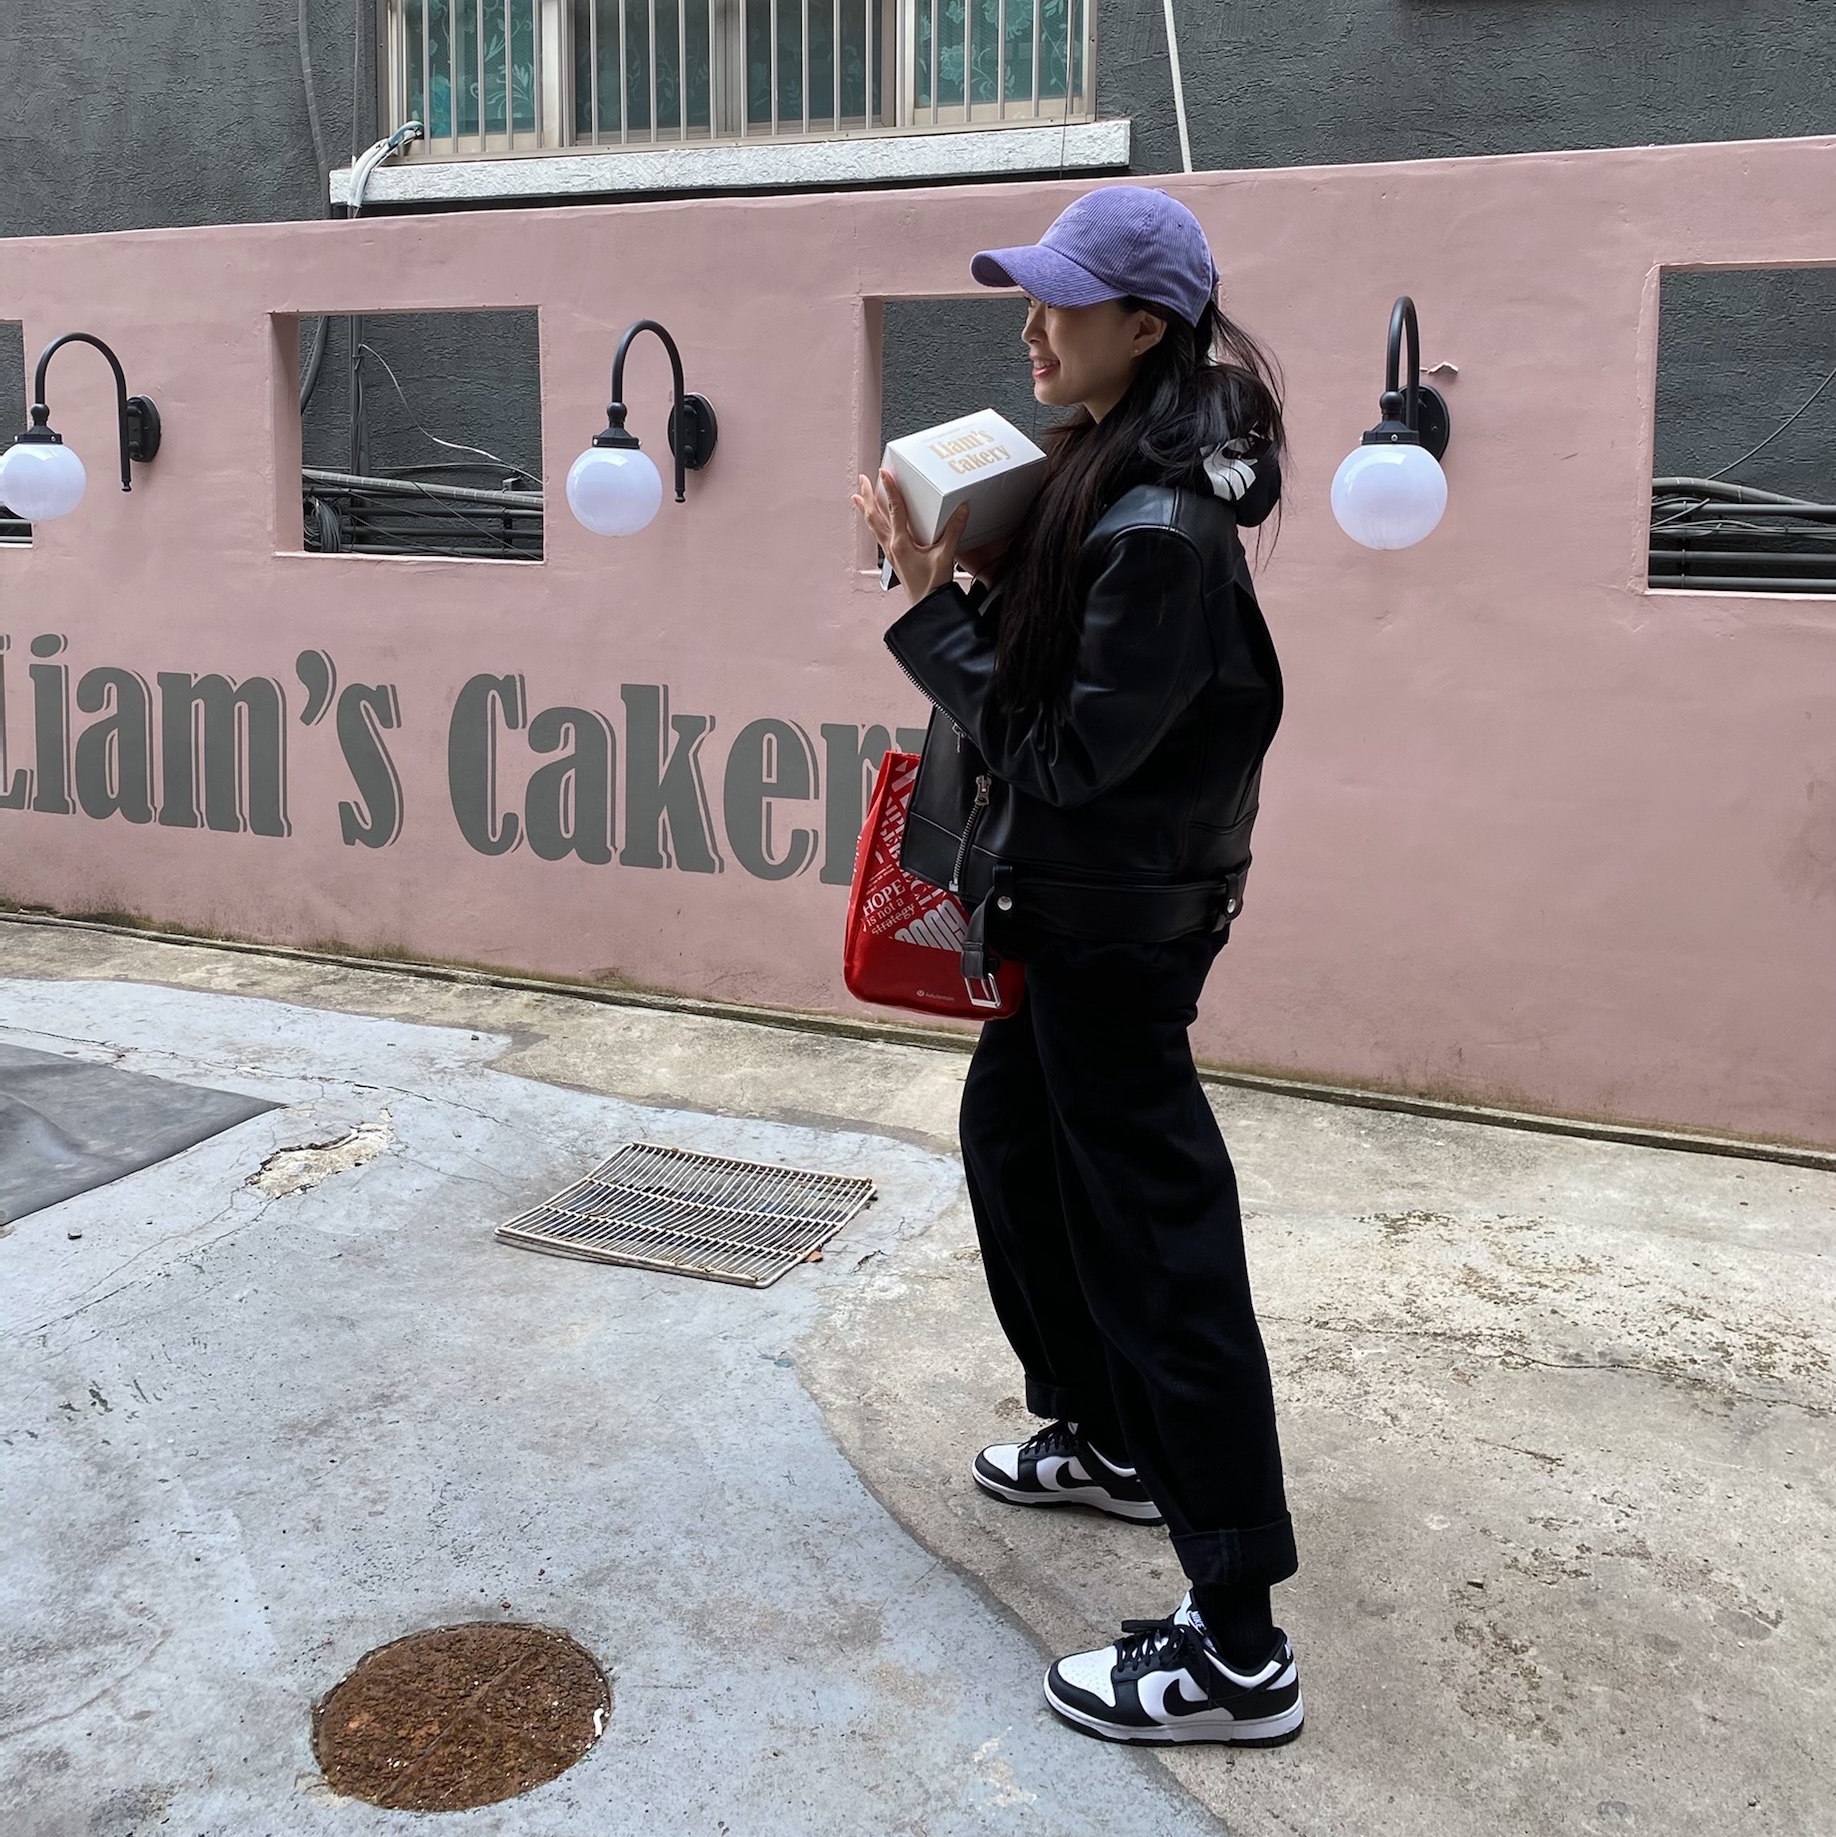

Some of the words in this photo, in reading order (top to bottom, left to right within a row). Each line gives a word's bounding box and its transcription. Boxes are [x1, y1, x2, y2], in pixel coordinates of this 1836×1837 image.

[928, 430, 996, 460] Liam's
[948, 445, 1012, 475] Cakery
[448, 673, 930, 887] Caker
[863, 879, 906, 917] HOPE
[866, 915, 877, 927] is
[877, 902, 896, 920] not
[896, 898, 905, 907] a
[871, 903, 916, 935] strategy
[1190, 1610, 1205, 1629] NIKE
